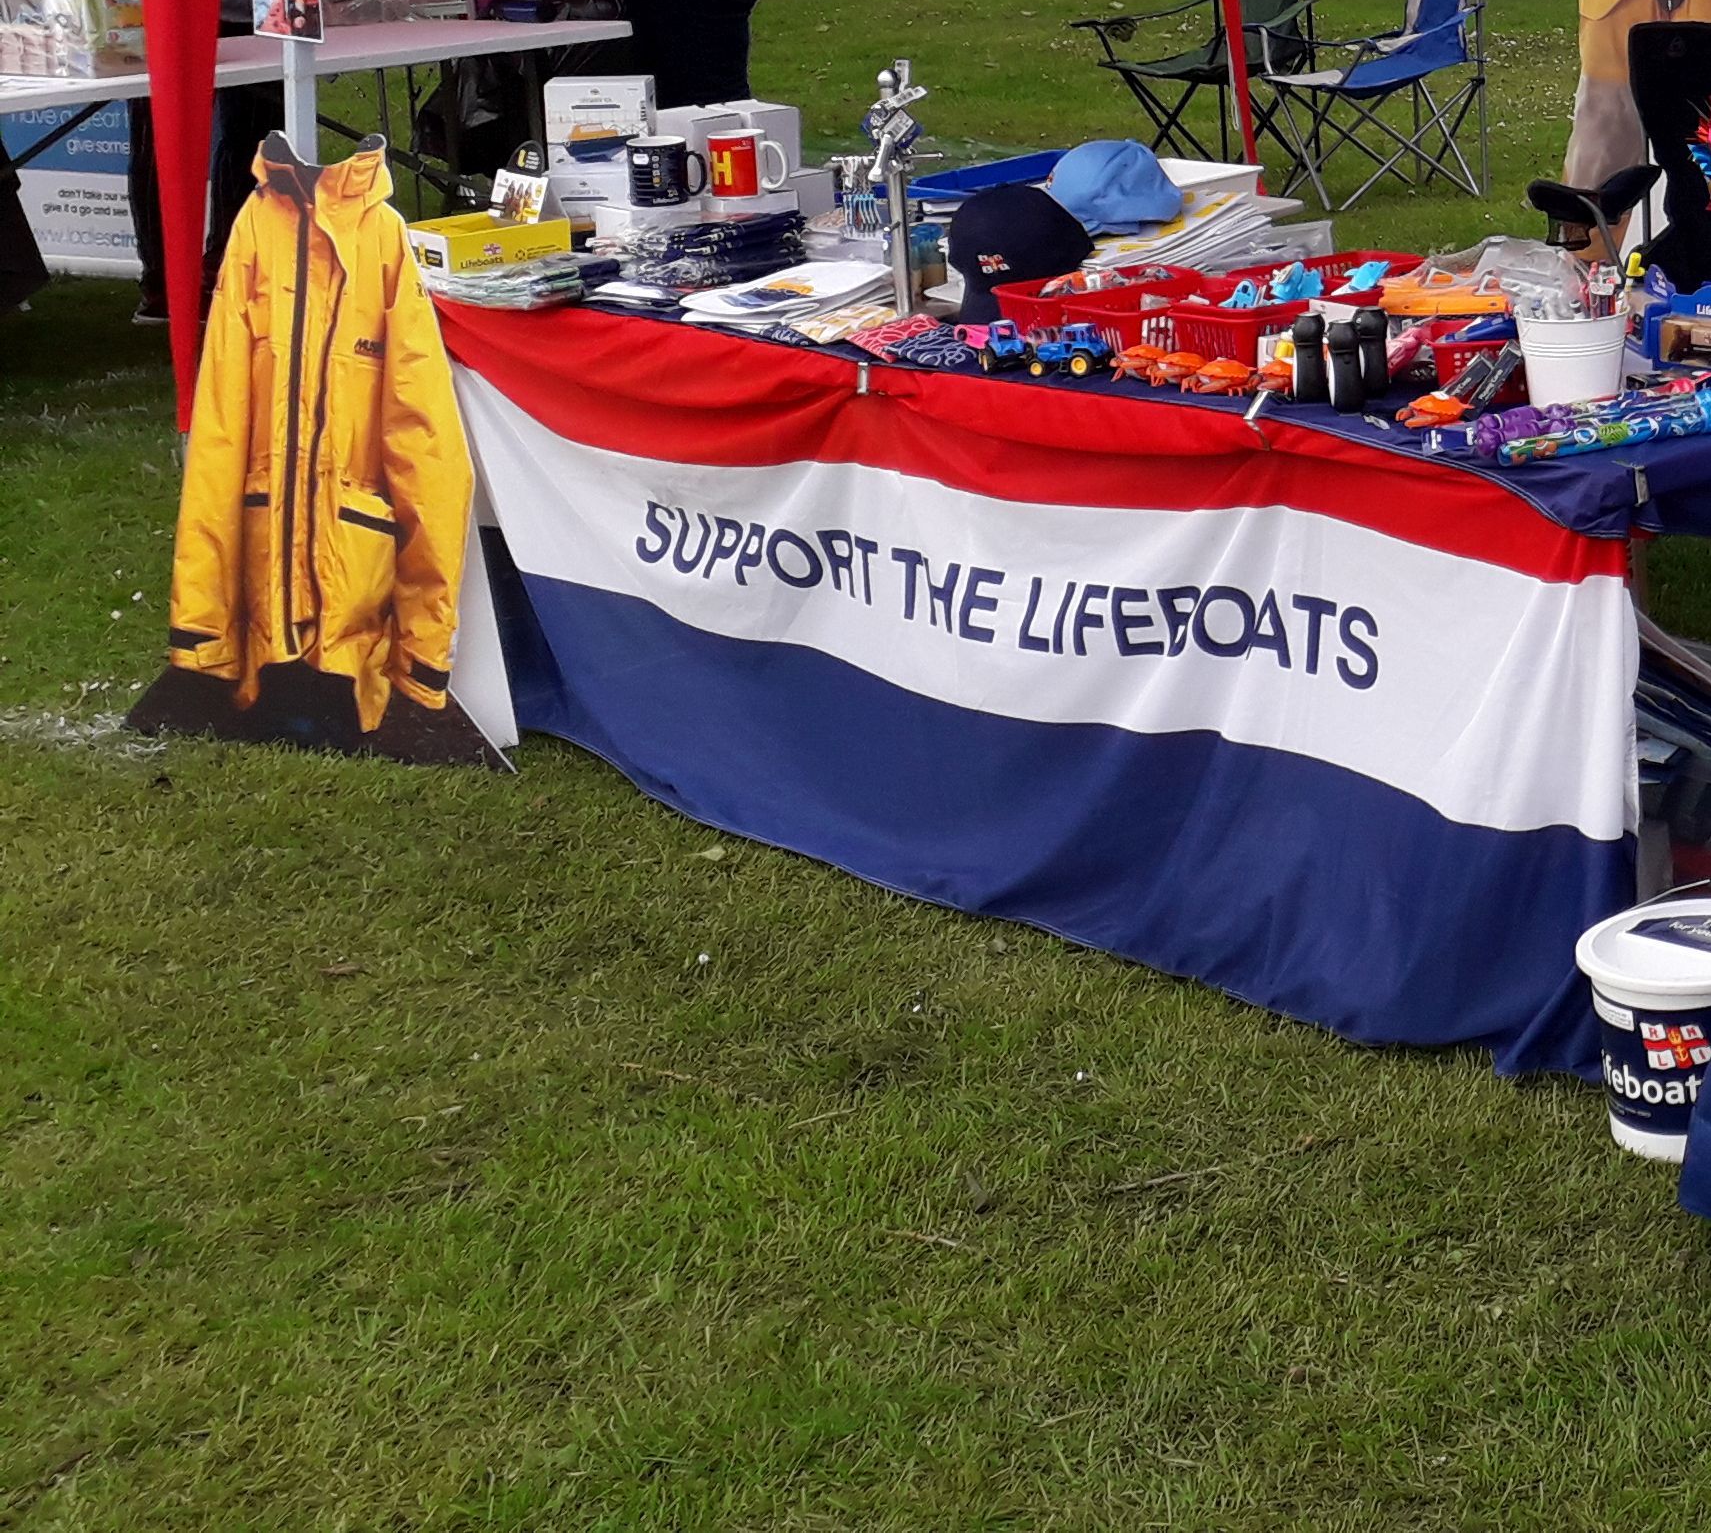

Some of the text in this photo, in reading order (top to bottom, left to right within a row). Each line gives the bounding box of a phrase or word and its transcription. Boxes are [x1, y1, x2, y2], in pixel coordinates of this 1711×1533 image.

[67, 138, 130, 155] give some
[635, 501, 1380, 689] SUPPORT THE LIFEBOATS
[1601, 1049, 1704, 1104] ifeboat
